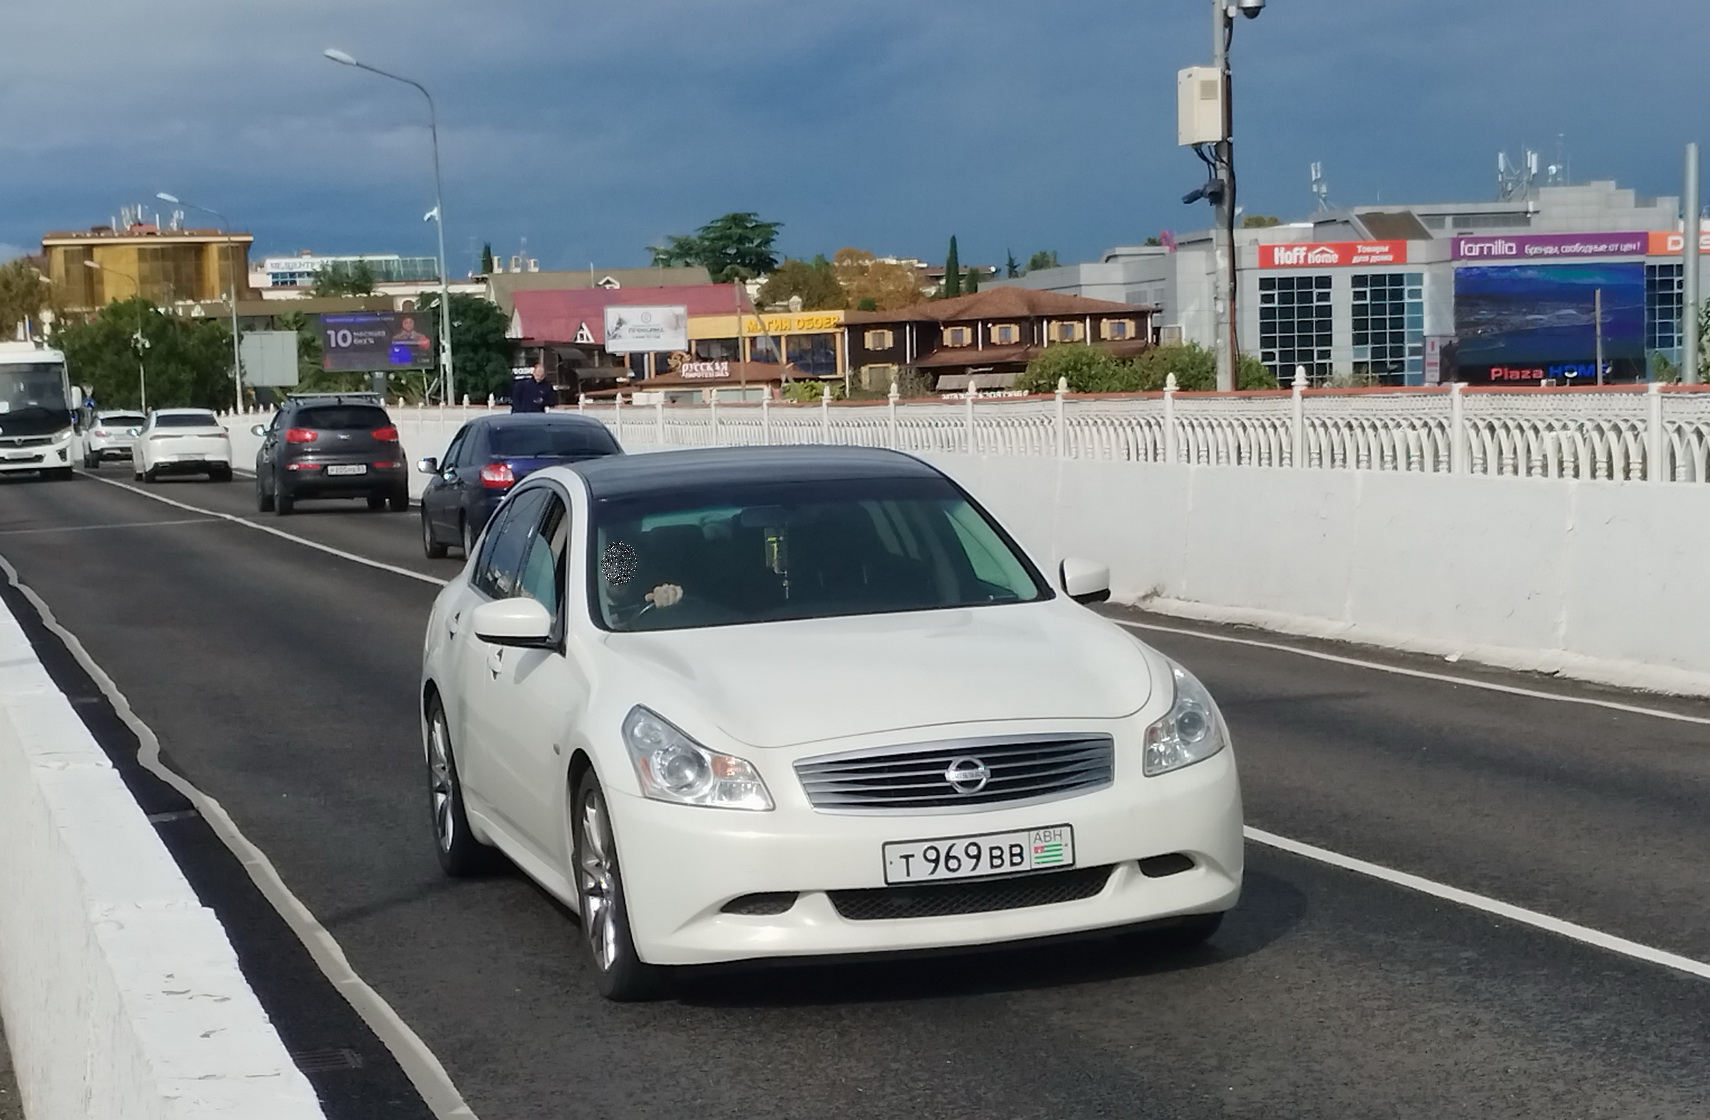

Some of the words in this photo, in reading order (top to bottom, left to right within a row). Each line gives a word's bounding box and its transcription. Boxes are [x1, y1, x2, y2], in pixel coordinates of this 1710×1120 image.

[1274, 246, 1307, 265] Hoff
[1460, 240, 1517, 256] familia
[1560, 243, 1607, 254] свободные
[1608, 243, 1619, 252] от
[326, 329, 353, 348] 10
[1490, 367, 1544, 380] Plaza
[1033, 829, 1063, 844] ABH
